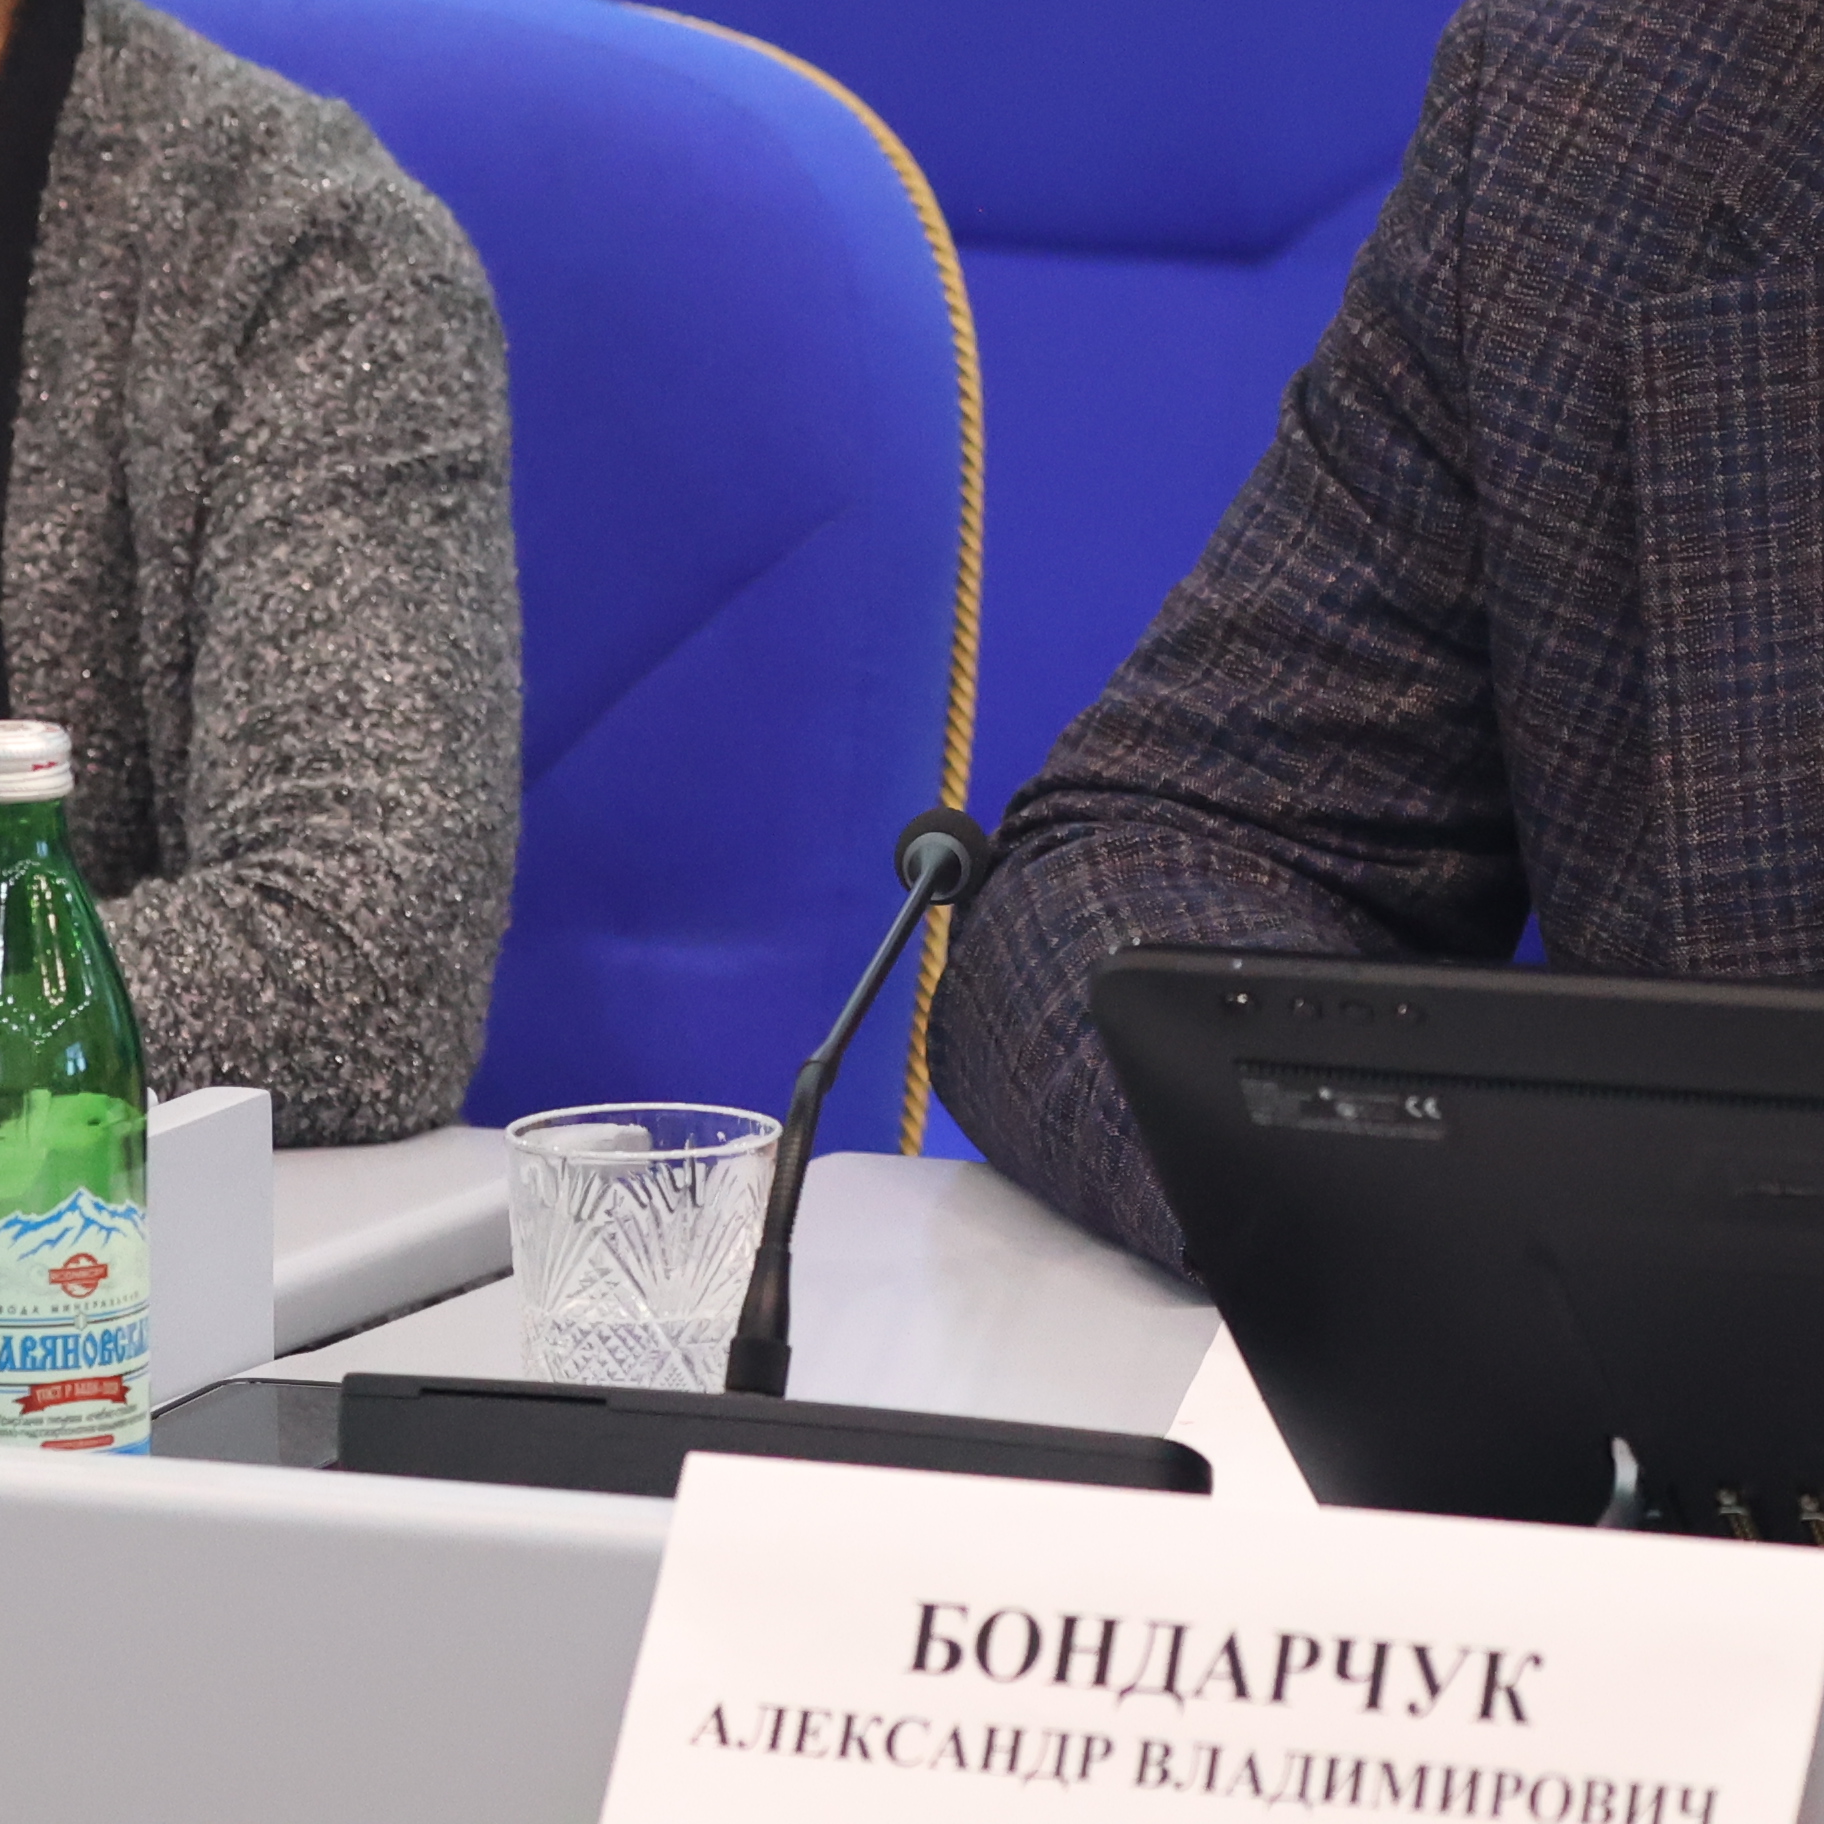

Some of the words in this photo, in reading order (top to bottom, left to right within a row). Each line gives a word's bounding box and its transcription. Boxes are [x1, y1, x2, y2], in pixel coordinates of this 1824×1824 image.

[907, 1600, 1542, 1724] БОНДАРЧУК
[689, 1700, 1114, 1790] АЛЕКСАНДР
[1134, 1739, 1720, 1824] ВЛАДИМИРОВИЧ
